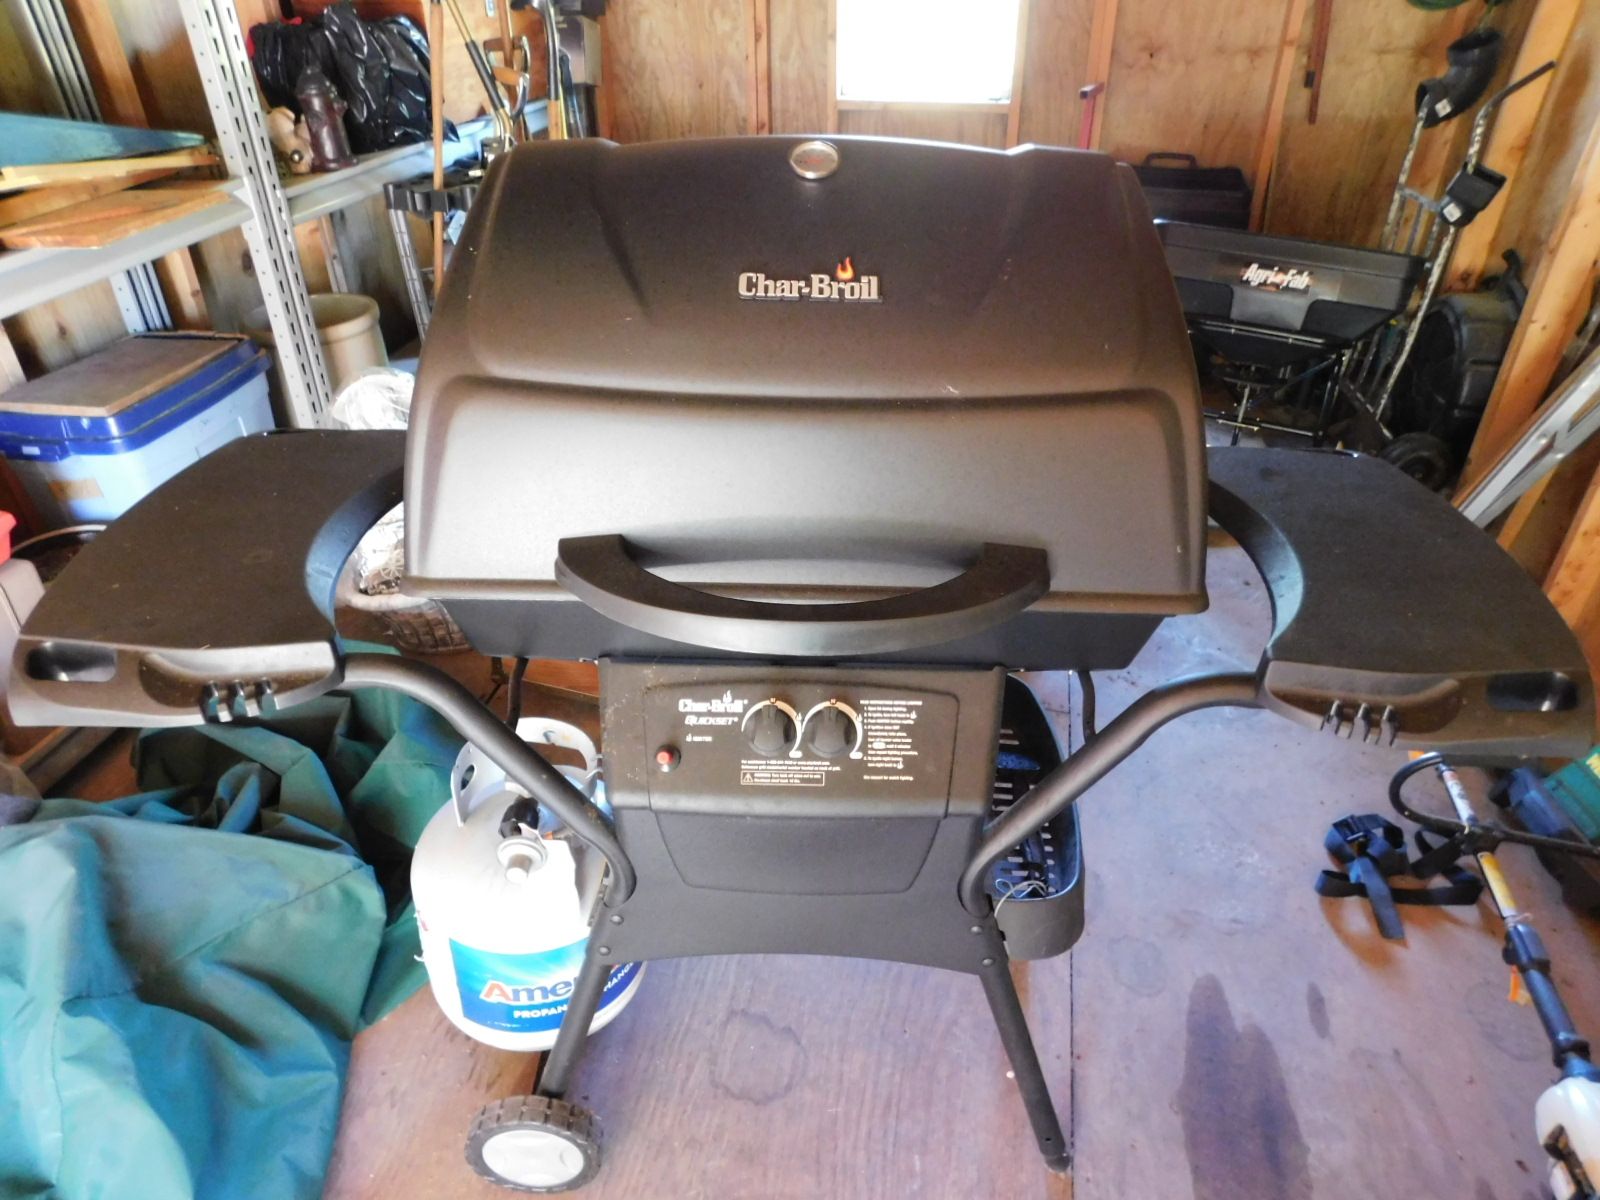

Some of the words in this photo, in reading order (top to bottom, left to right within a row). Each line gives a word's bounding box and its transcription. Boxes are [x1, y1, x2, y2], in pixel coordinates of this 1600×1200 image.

[738, 272, 880, 300] Char-Broil
[678, 698, 744, 713] Char-Broil
[483, 980, 575, 1002] Ame
[513, 1004, 569, 1018] PROPAN
